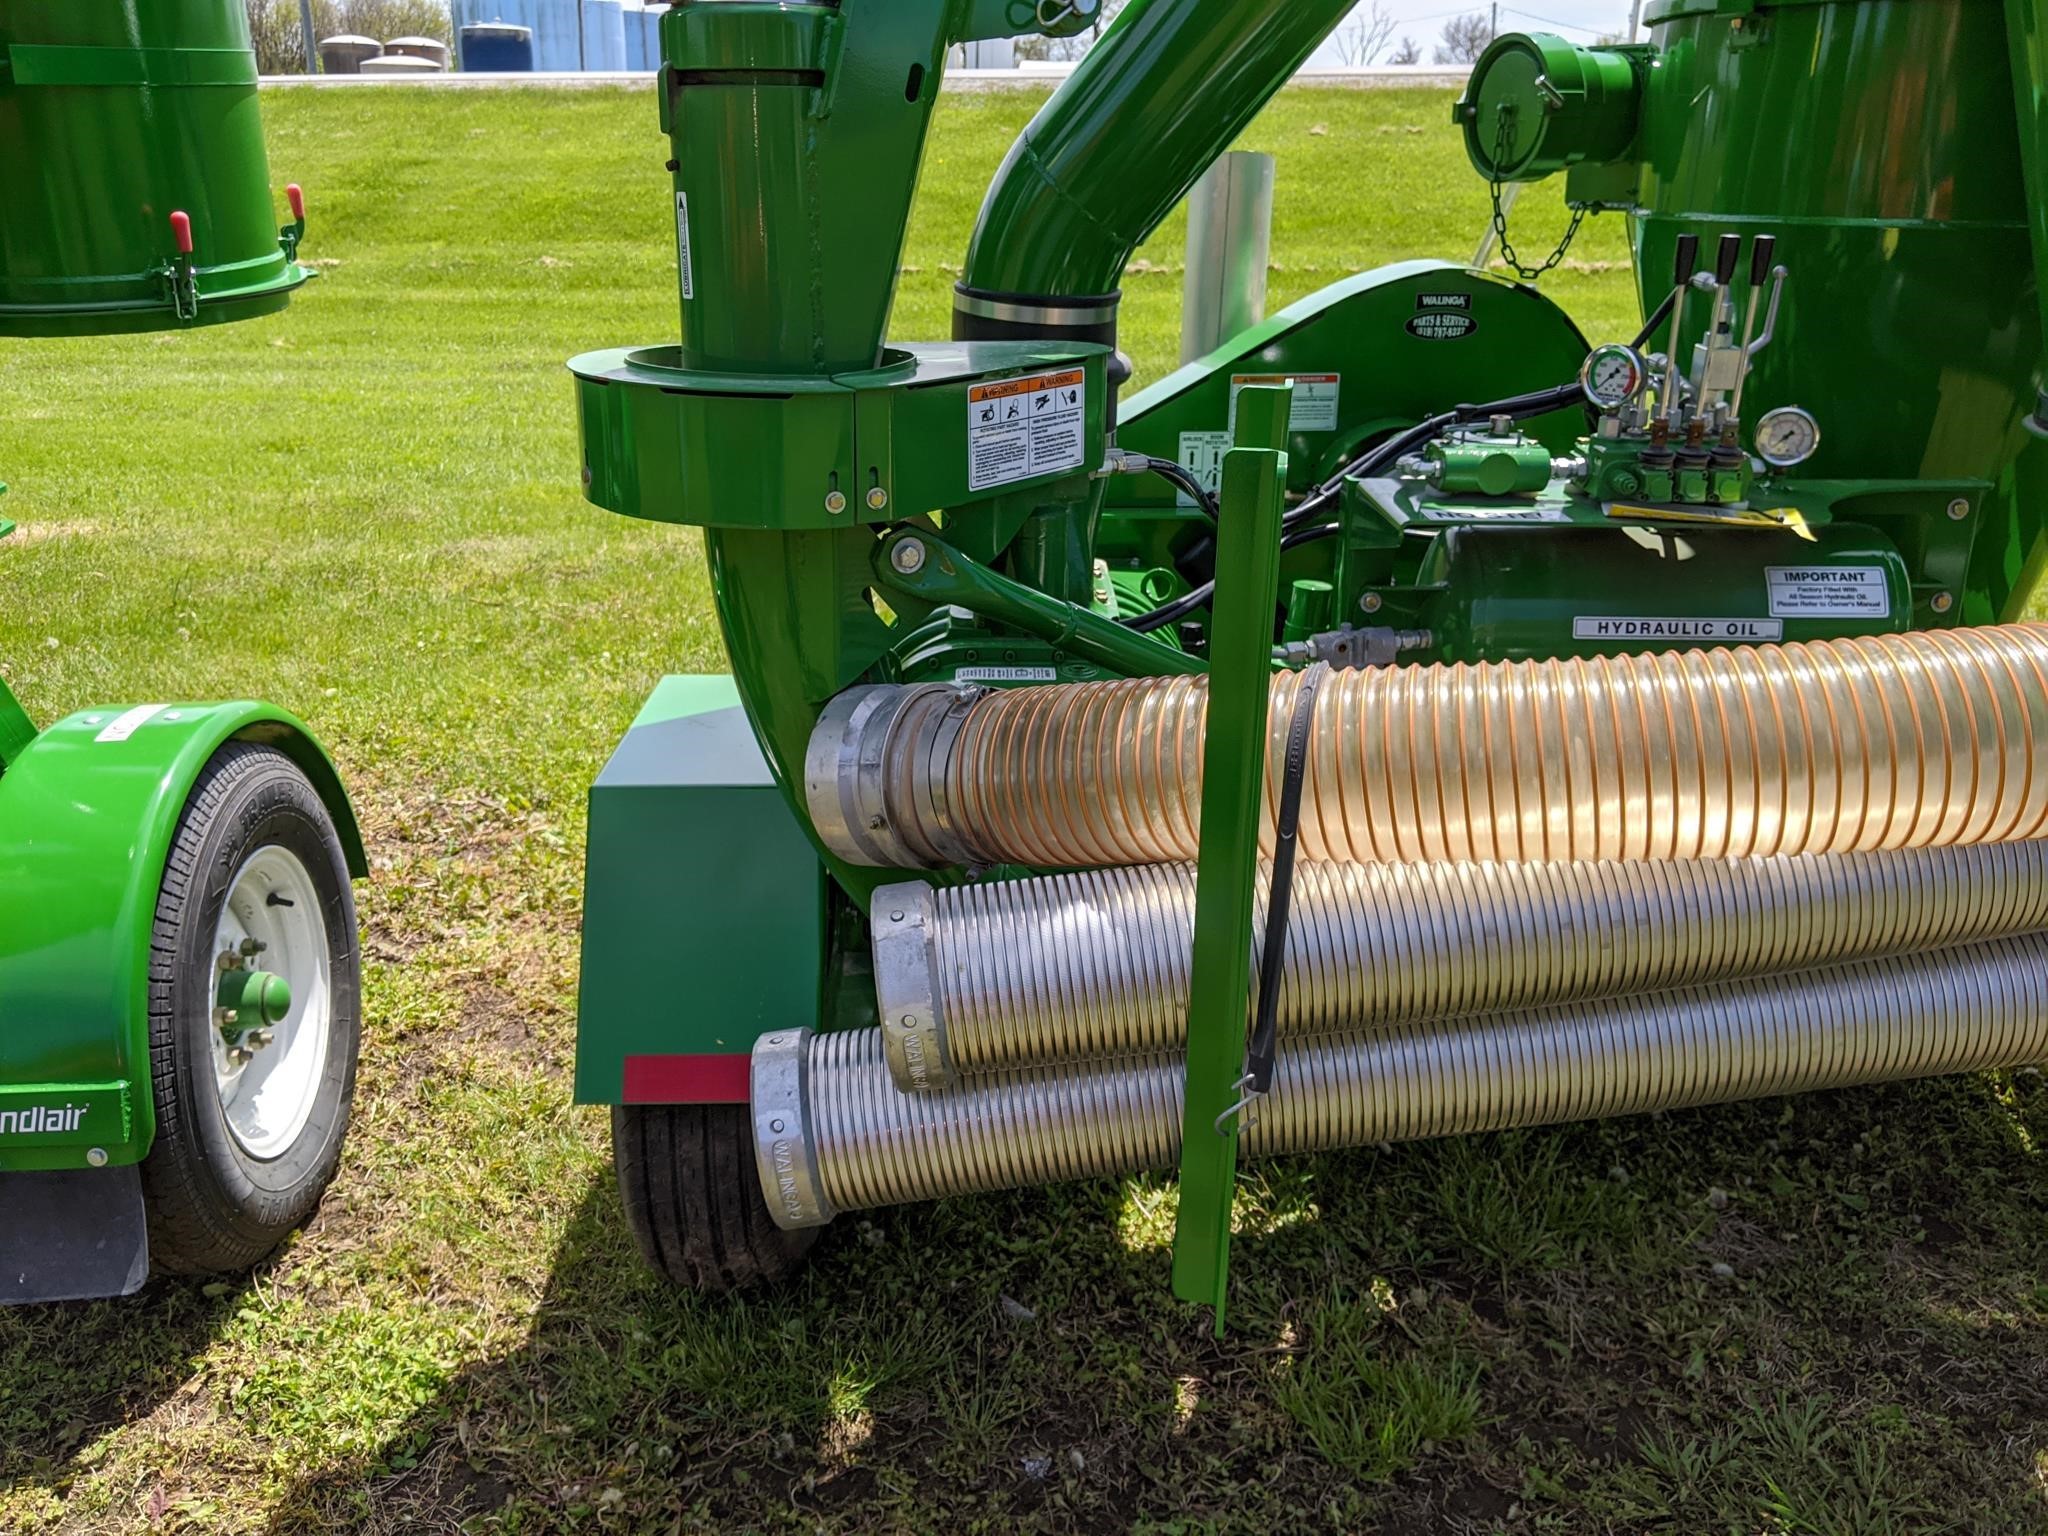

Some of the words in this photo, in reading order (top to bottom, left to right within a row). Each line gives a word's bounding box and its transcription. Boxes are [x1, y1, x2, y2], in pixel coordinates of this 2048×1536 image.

[1421, 295, 1466, 307] WALINGA
[1412, 314, 1435, 327] PARTS
[1435, 314, 1441, 326] &
[1441, 314, 1470, 327] SERVICE
[1046, 374, 1074, 387] WARNING
[1784, 572, 1866, 582] IMPORTANT
[1598, 621, 1714, 636] HYDRAULIC
[1726, 622, 1759, 636] OIL
